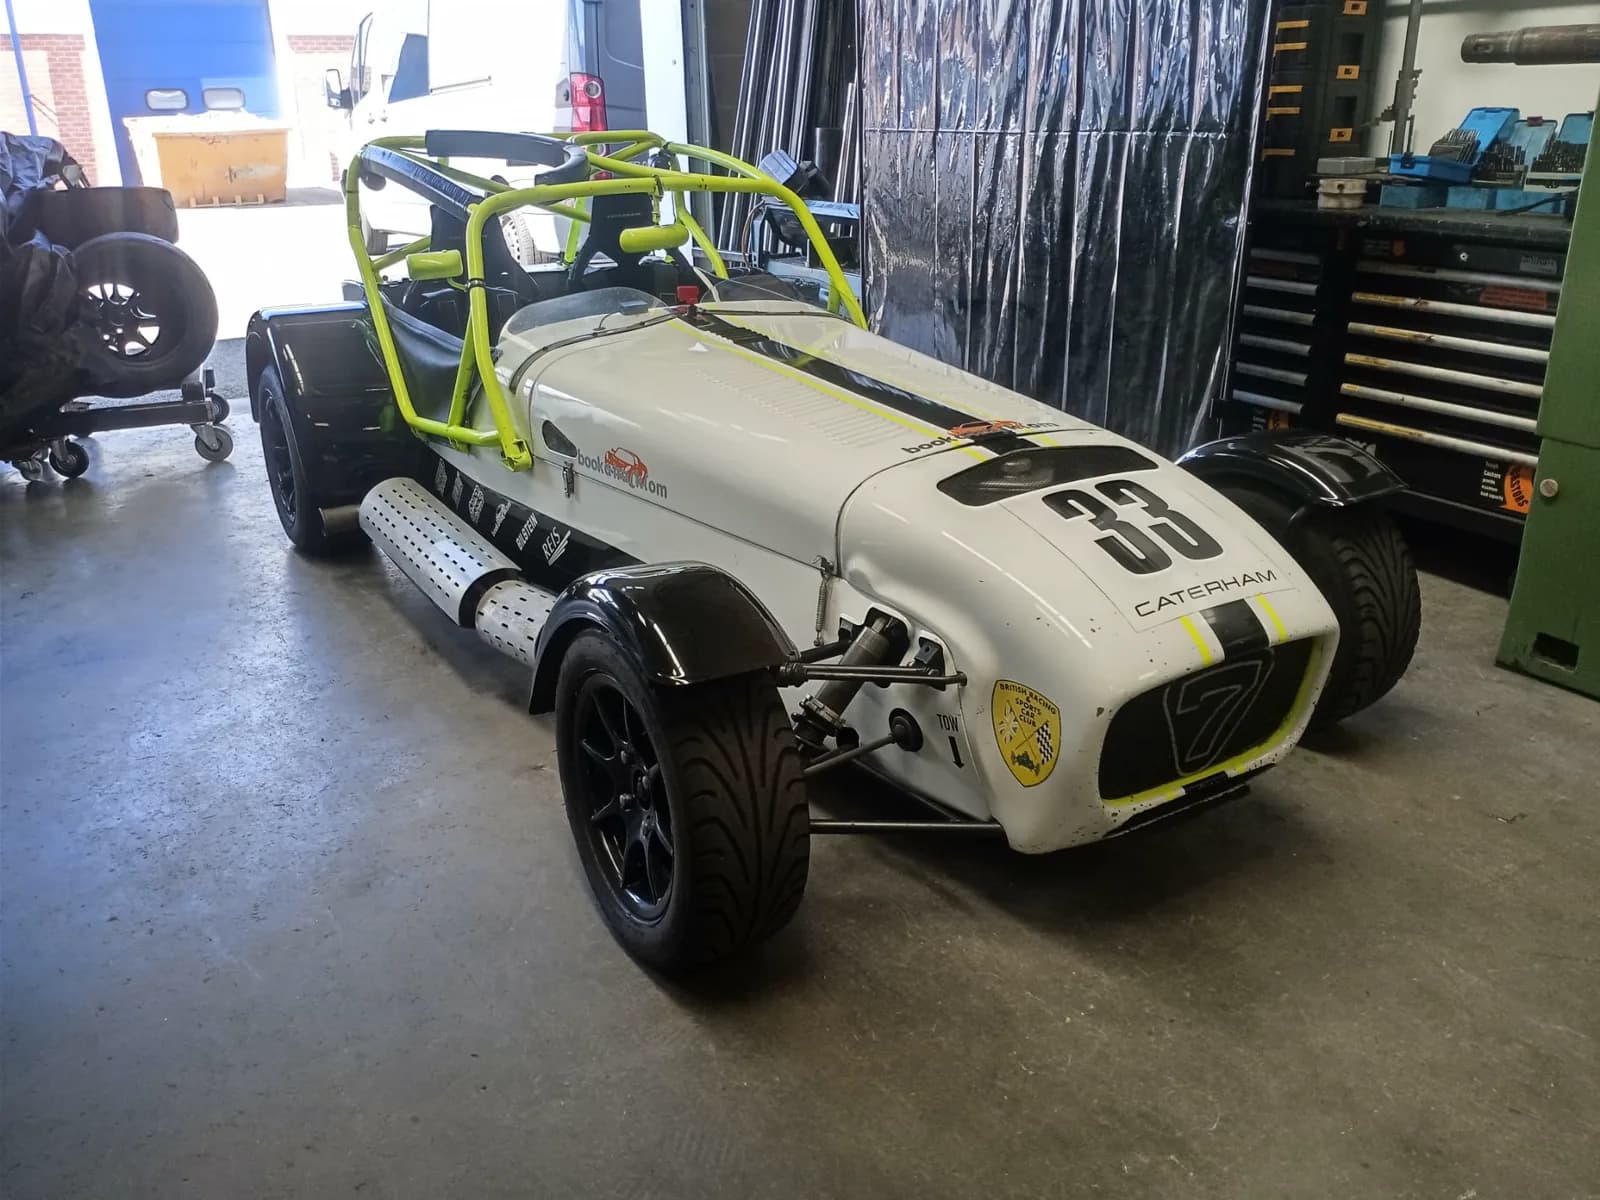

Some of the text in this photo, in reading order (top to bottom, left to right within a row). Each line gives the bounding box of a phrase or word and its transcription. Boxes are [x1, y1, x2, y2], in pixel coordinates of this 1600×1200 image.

[515, 512, 539, 551] BILSTEIN
[542, 526, 561, 560] REIS
[1041, 479, 1224, 575] 33
[1134, 569, 1277, 617] CATERHAM
[999, 683, 1057, 715] BRITISH RACING
[1015, 697, 1042, 716] SPORTS
[1020, 708, 1036, 719] CAR
[936, 713, 959, 732] TOW
[1018, 714, 1037, 728] CLUB
